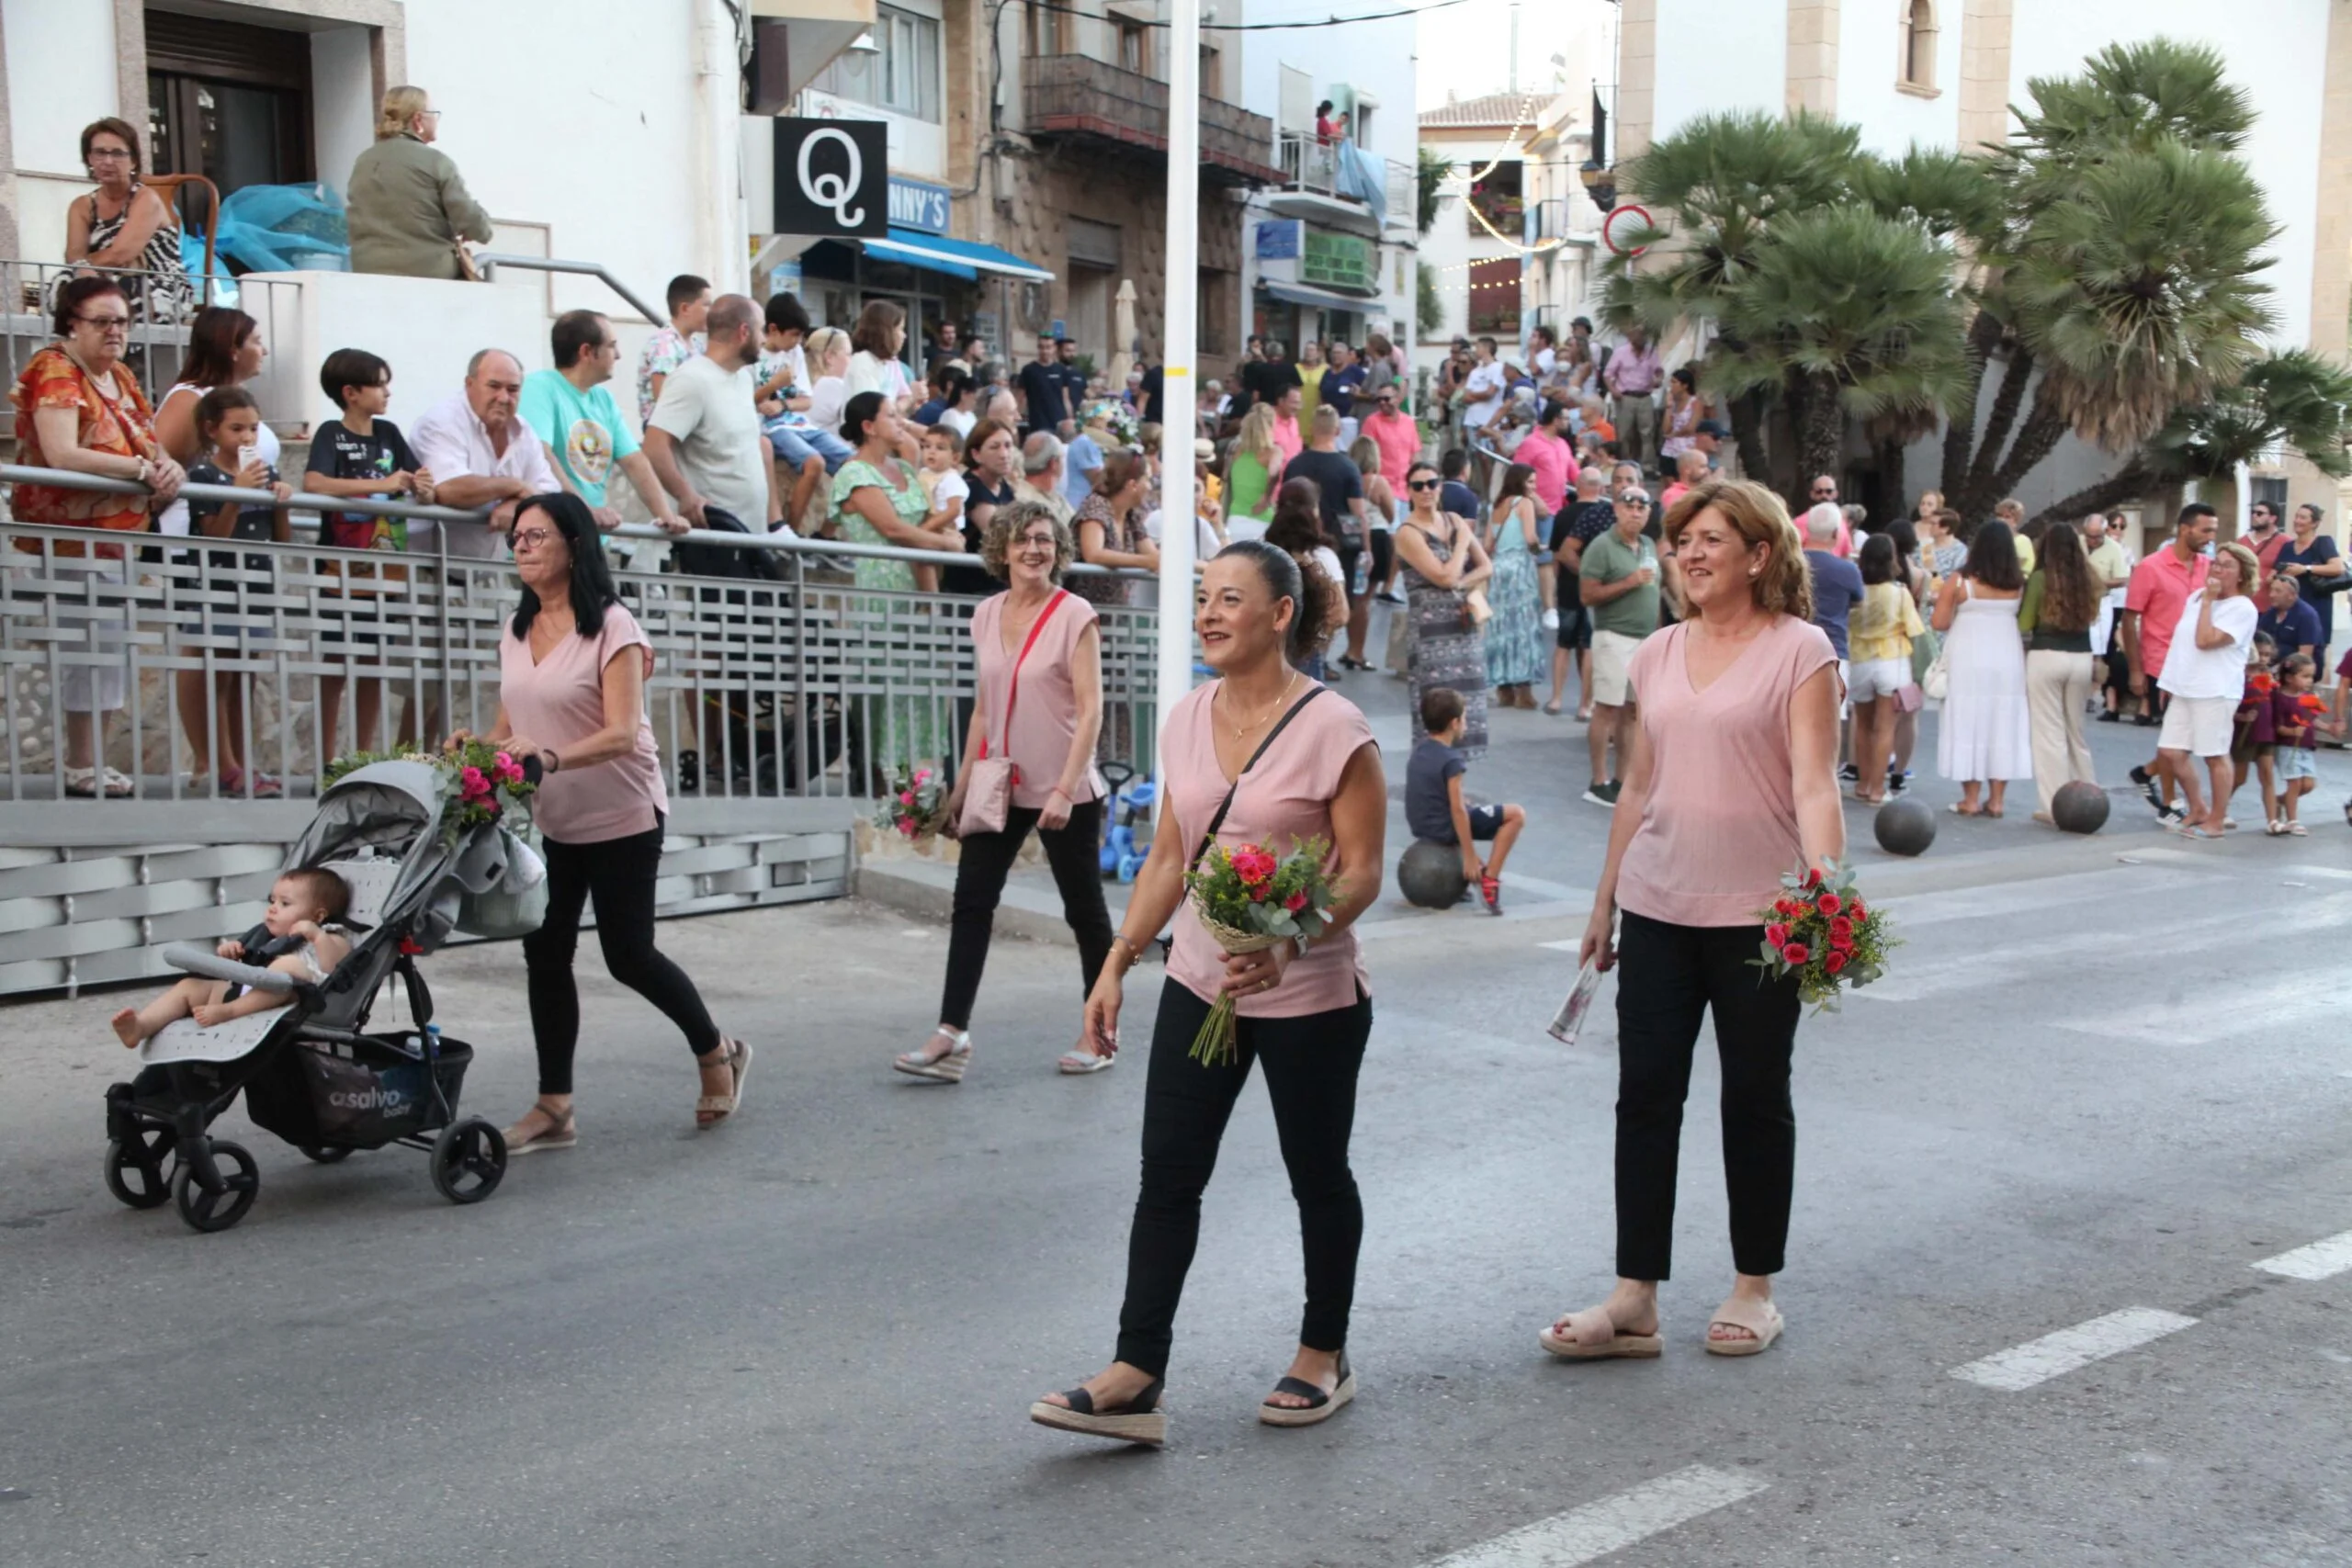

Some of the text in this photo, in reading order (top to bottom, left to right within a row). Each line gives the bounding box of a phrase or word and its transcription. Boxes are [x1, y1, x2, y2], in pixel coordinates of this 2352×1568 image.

[797, 128, 865, 228] Q
[888, 183, 944, 228] NNY'S
[329, 1086, 401, 1110] asalvo
